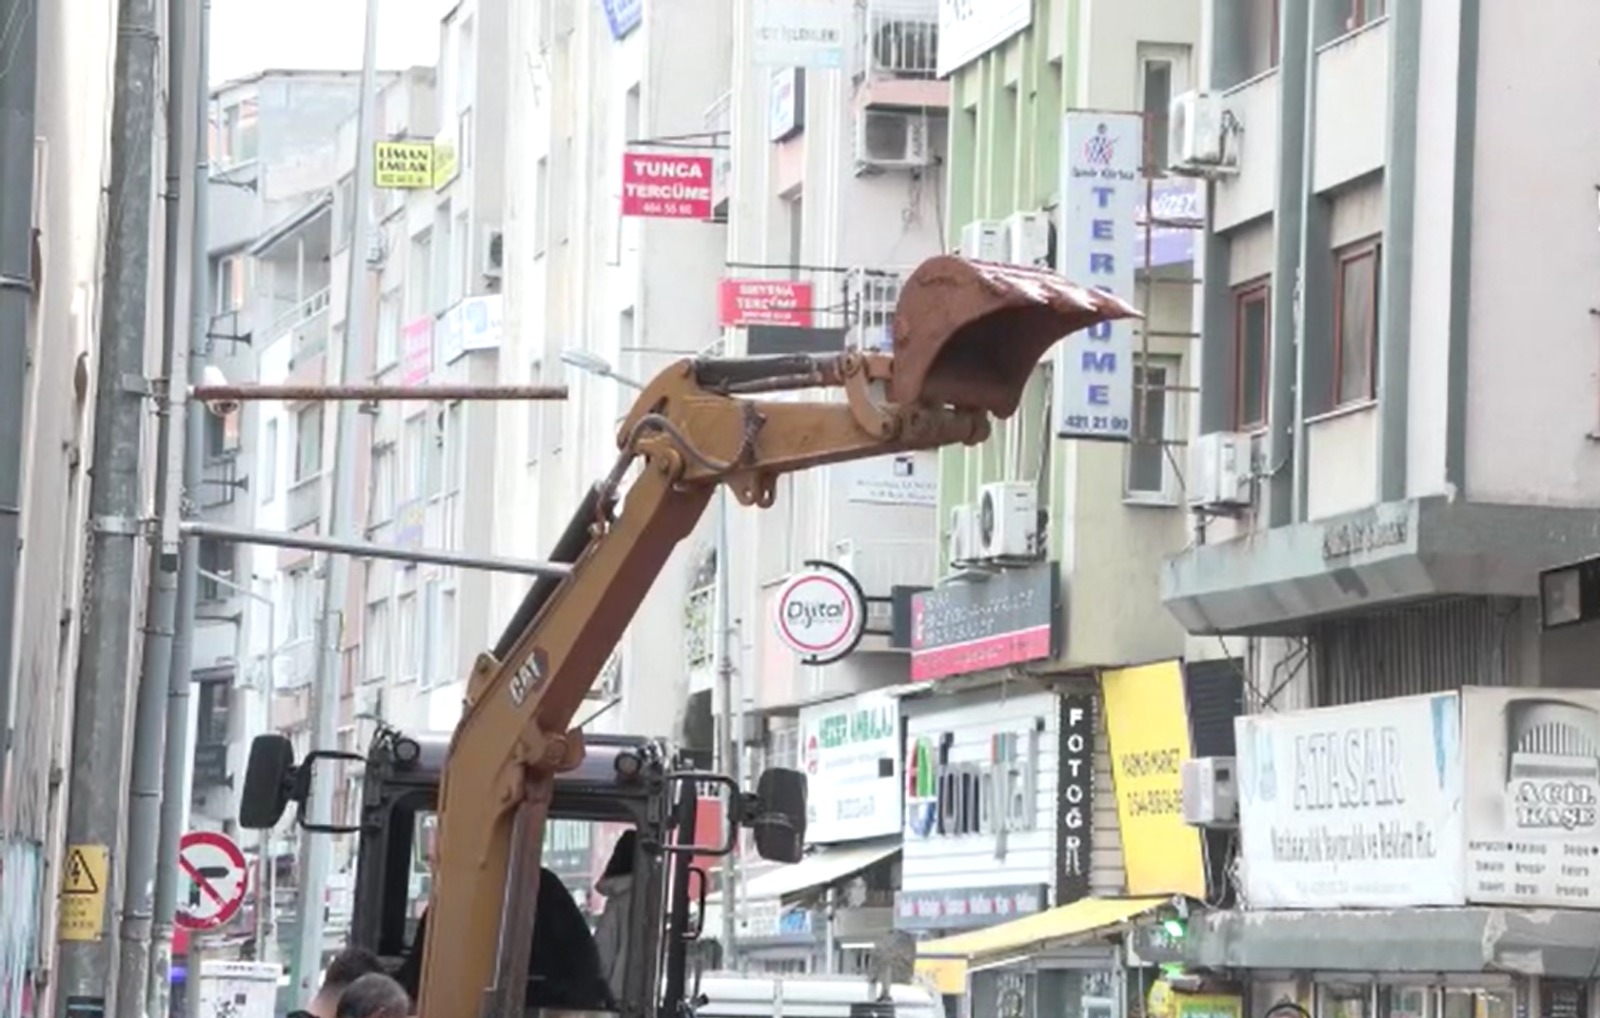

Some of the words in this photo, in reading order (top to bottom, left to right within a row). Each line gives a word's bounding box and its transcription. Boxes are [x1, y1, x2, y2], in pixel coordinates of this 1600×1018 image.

[633, 161, 703, 178] TUNCA
[625, 182, 709, 201] TERCÜME
[508, 650, 541, 705] CAT
[1293, 727, 1406, 812] ATASAR
